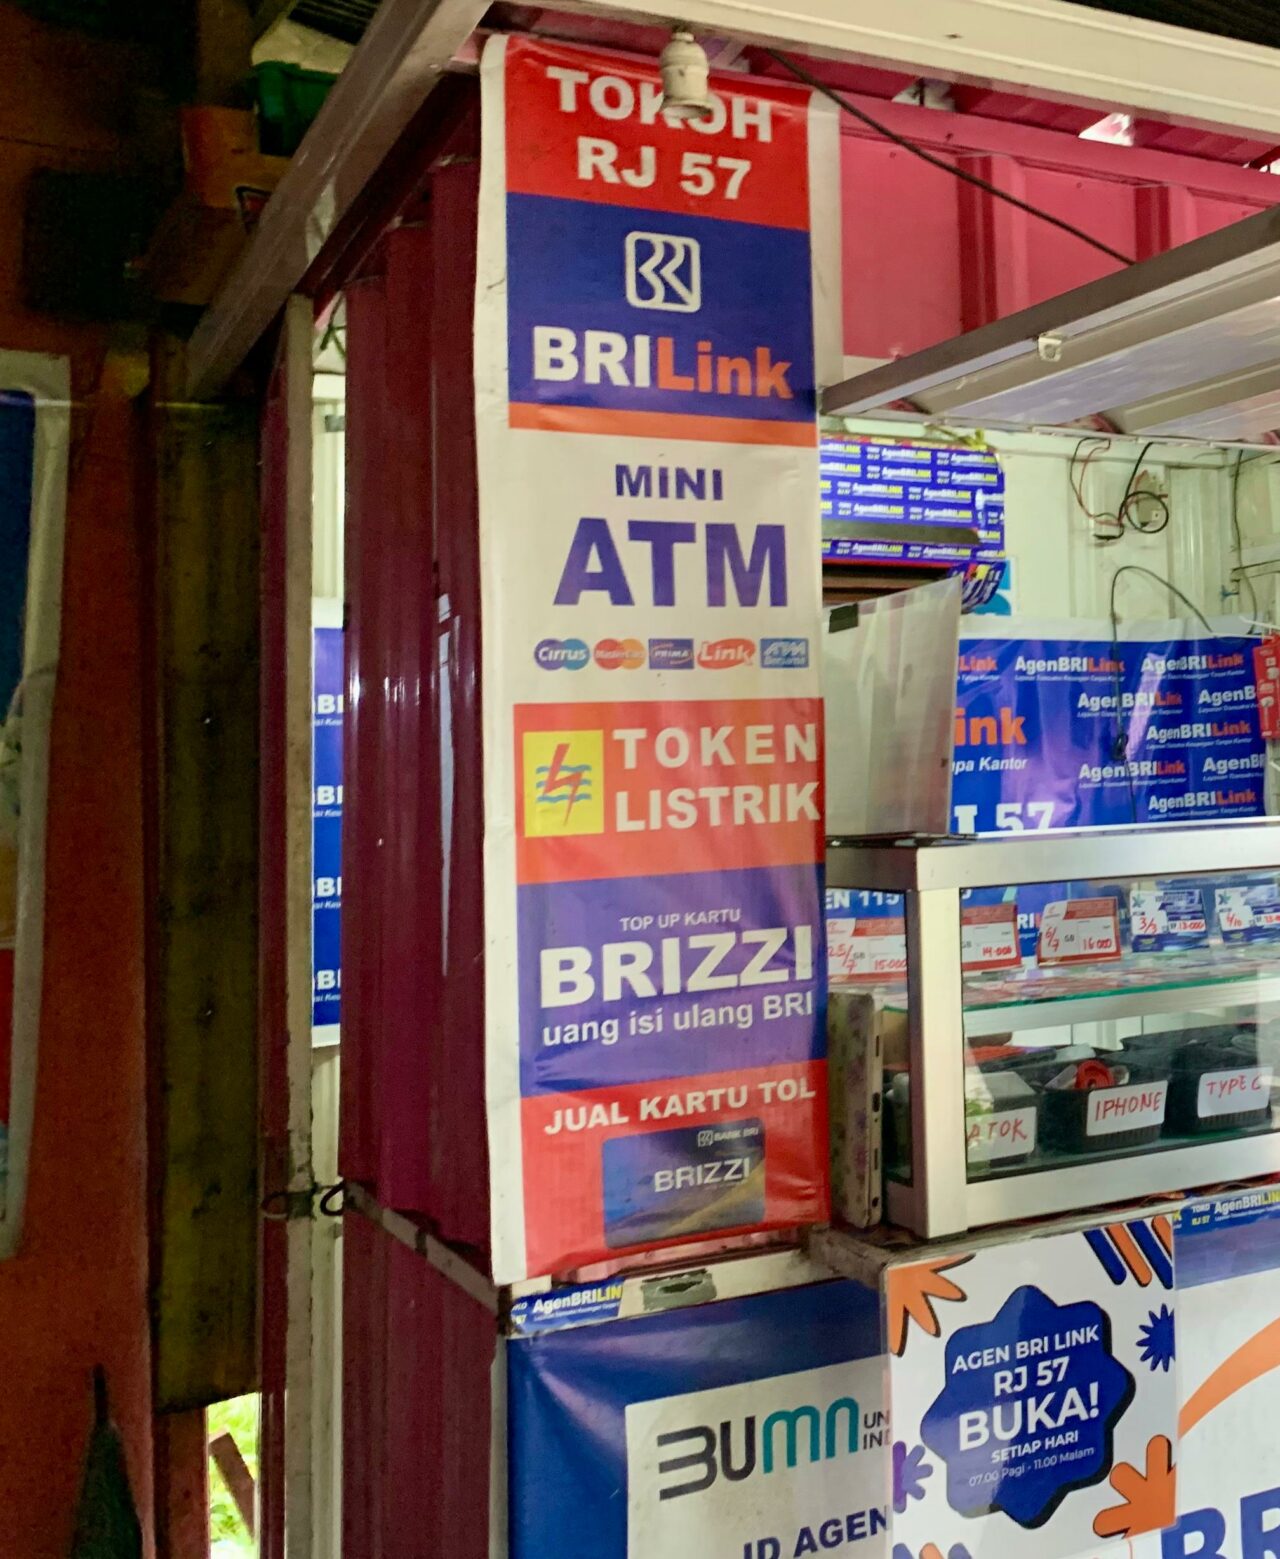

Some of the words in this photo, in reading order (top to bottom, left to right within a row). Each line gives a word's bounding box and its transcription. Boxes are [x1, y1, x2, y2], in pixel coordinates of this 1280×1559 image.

[577, 136, 656, 188] RJ
[680, 152, 751, 200] 57
[533, 326, 793, 398] BRILink
[616, 464, 723, 500] MINI
[553, 517, 787, 607] ATM
[538, 647, 586, 661] Cirrus
[612, 723, 817, 770] TOKEN
[1146, 720, 1251, 743] AgenBRILink
[979, 757, 1028, 771] Kantor
[616, 781, 820, 833] LISTRIK
[1148, 788, 1256, 813] AgenBRILink
[620, 914, 654, 933] TOP
[659, 913, 680, 928] UP
[685, 908, 742, 926] KARTU
[540, 925, 814, 1010] BRIZZI
[543, 1015, 619, 1048] uang
[630, 1009, 664, 1036] isi
[674, 1001, 753, 1032] ulang
[763, 990, 814, 1021] BRI
[544, 1101, 629, 1135] JUAL
[640, 1087, 749, 1121] KARTU
[758, 1077, 816, 1104] TOL
[1206, 1075, 1246, 1098] TYPE
[1095, 1092, 1162, 1121] IPHONE
[654, 1157, 751, 1194] BRIZZI
[952, 1345, 1009, 1374] AGEN
[1016, 1335, 1049, 1360] BRI
[1054, 1325, 1099, 1350] LINK
[994, 1365, 1029, 1397] RJ
[1037, 1357, 1070, 1386] 57
[960, 1382, 1099, 1451] BUKA!
[991, 1440, 1042, 1463] SETIAP
[1045, 1430, 1079, 1450] HARI
[969, 1469, 1000, 1486] 07.00
[1001, 1464, 1025, 1480] Pagi
[1060, 1447, 1095, 1463] Malam
